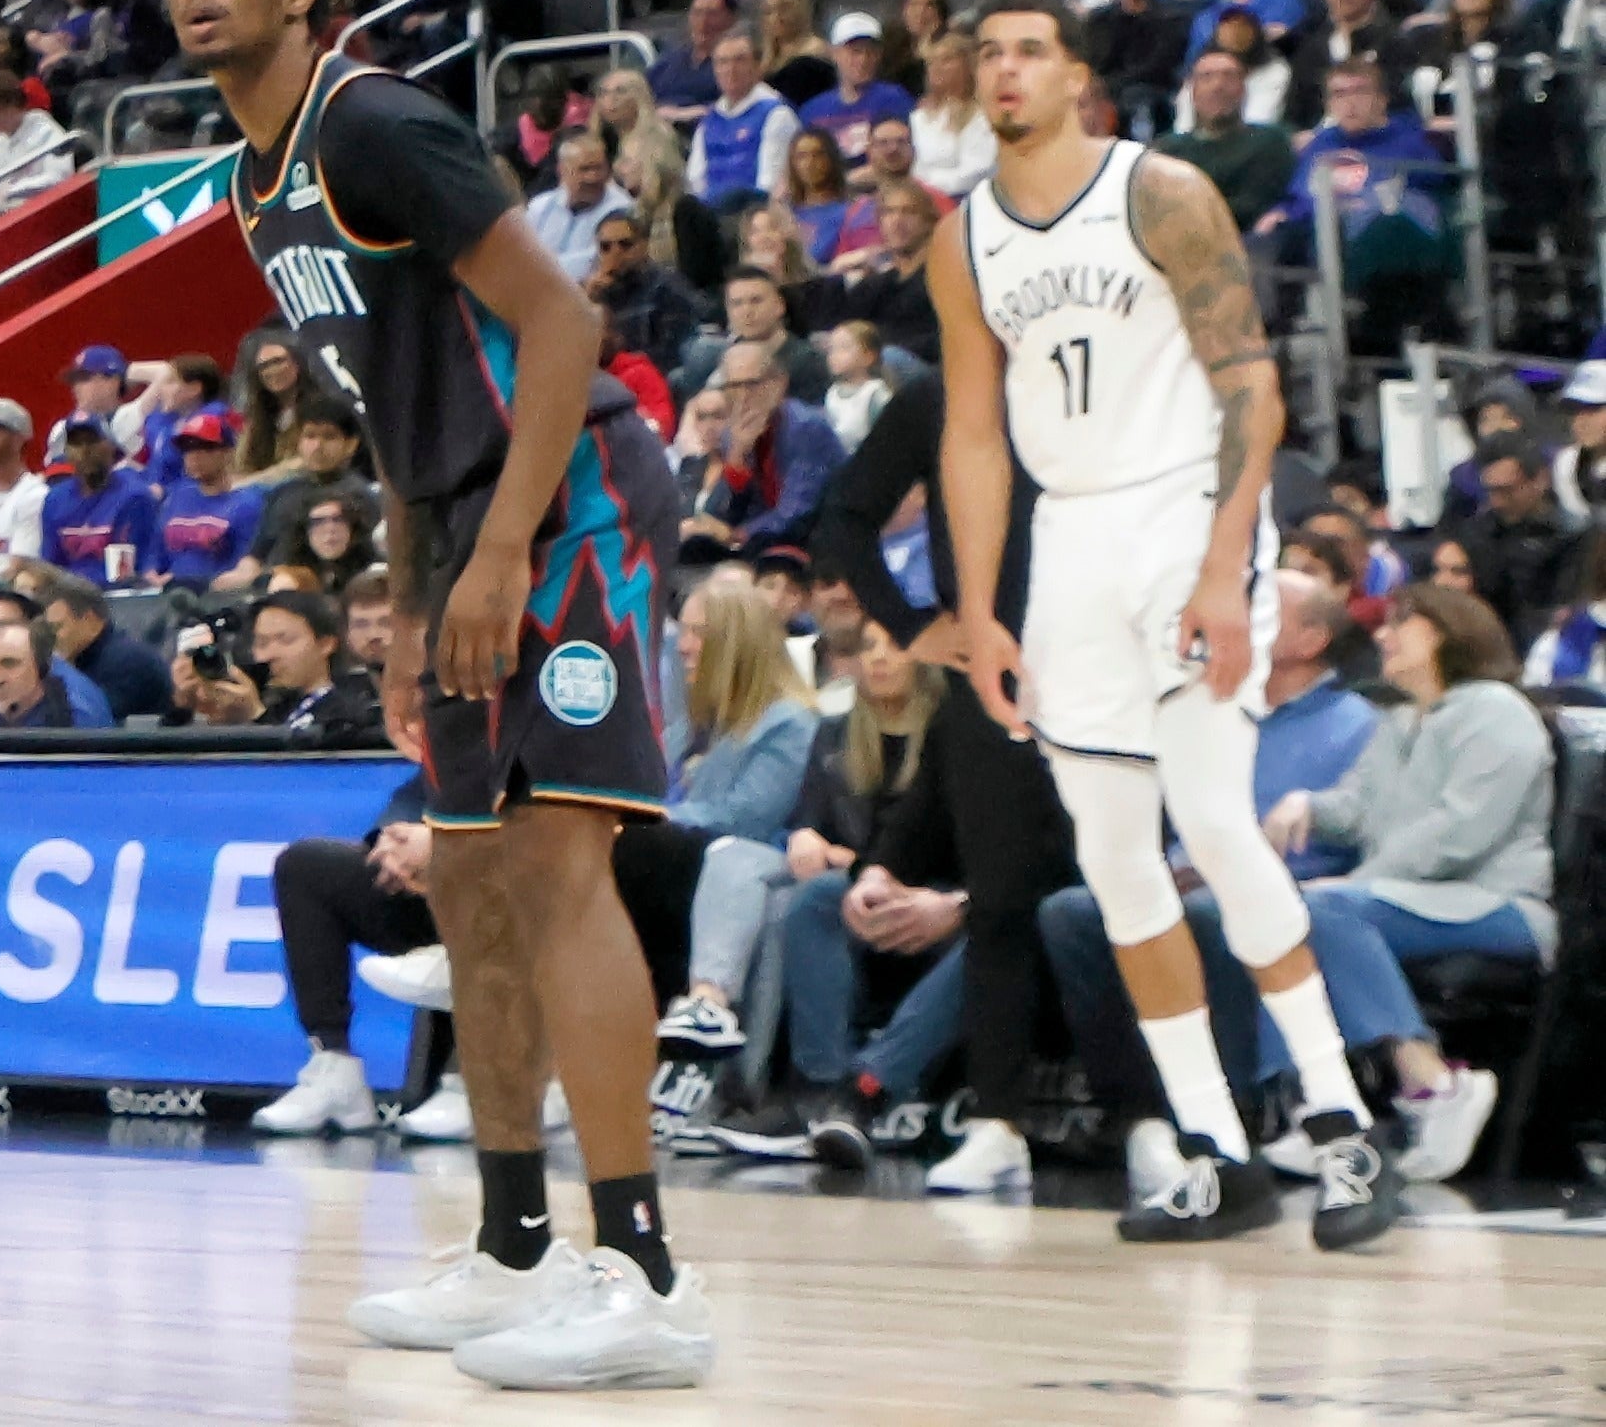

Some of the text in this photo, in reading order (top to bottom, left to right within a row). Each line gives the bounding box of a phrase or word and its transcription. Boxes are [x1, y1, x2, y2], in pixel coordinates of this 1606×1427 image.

[991, 264, 1144, 343] BROOKLYN
[1048, 337, 1091, 420] 17
[106, 1085, 205, 1117] StockX
